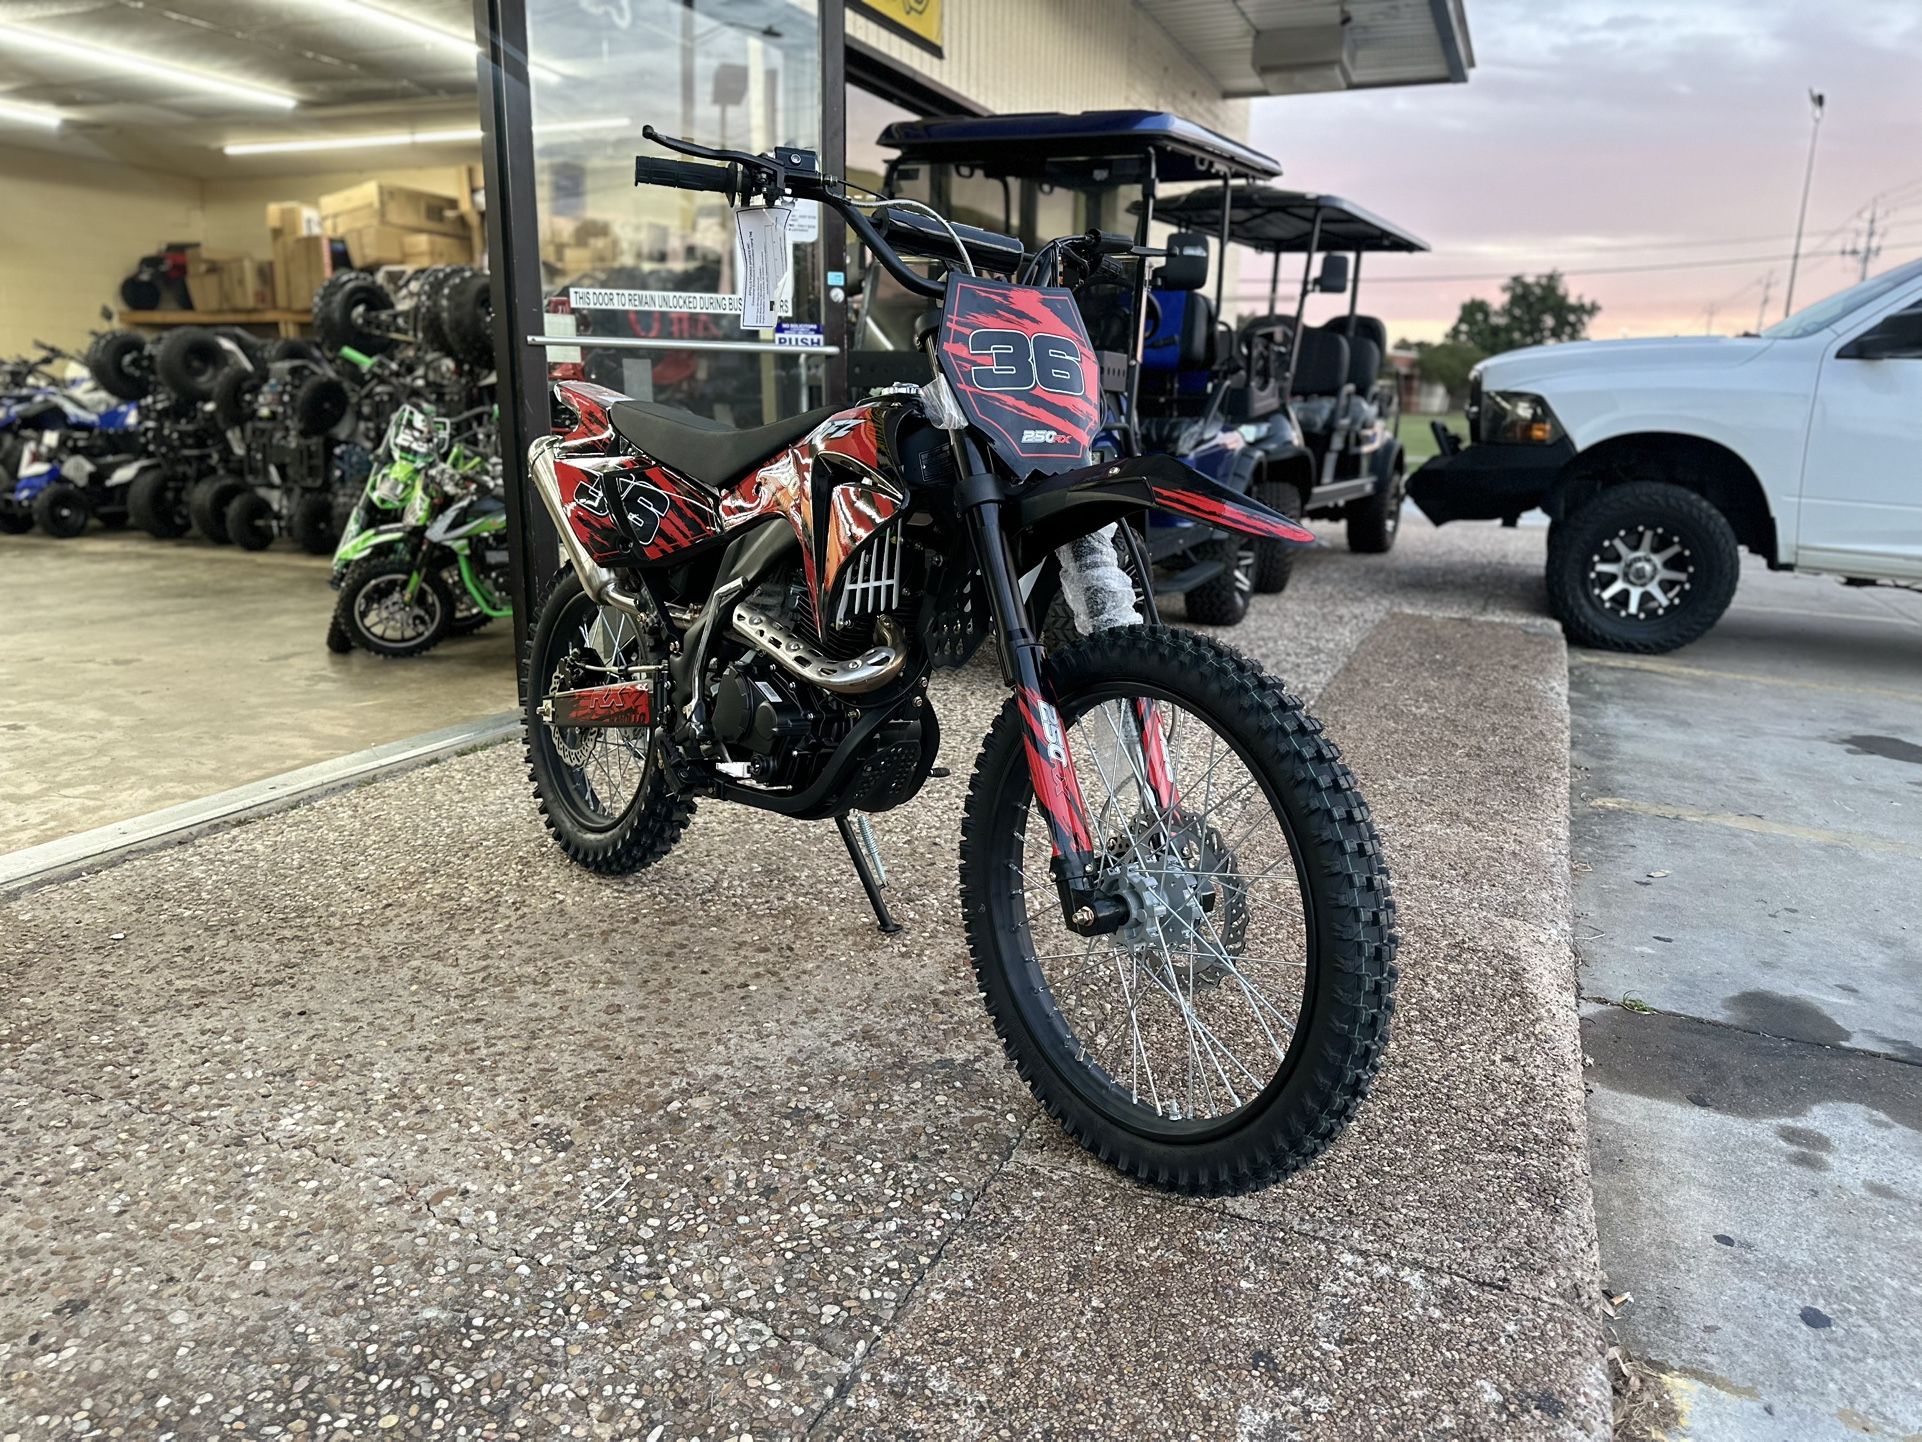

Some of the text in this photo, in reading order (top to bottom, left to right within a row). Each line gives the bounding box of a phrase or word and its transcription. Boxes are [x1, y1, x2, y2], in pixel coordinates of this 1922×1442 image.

[574, 291, 591, 305] THIS
[592, 292, 615, 306] DOOR
[616, 293, 626, 307] TO
[628, 293, 656, 308] REMAIN
[658, 294, 697, 309] UNLOCKED
[699, 296, 727, 311] DURING
[969, 329, 1085, 396] 36
